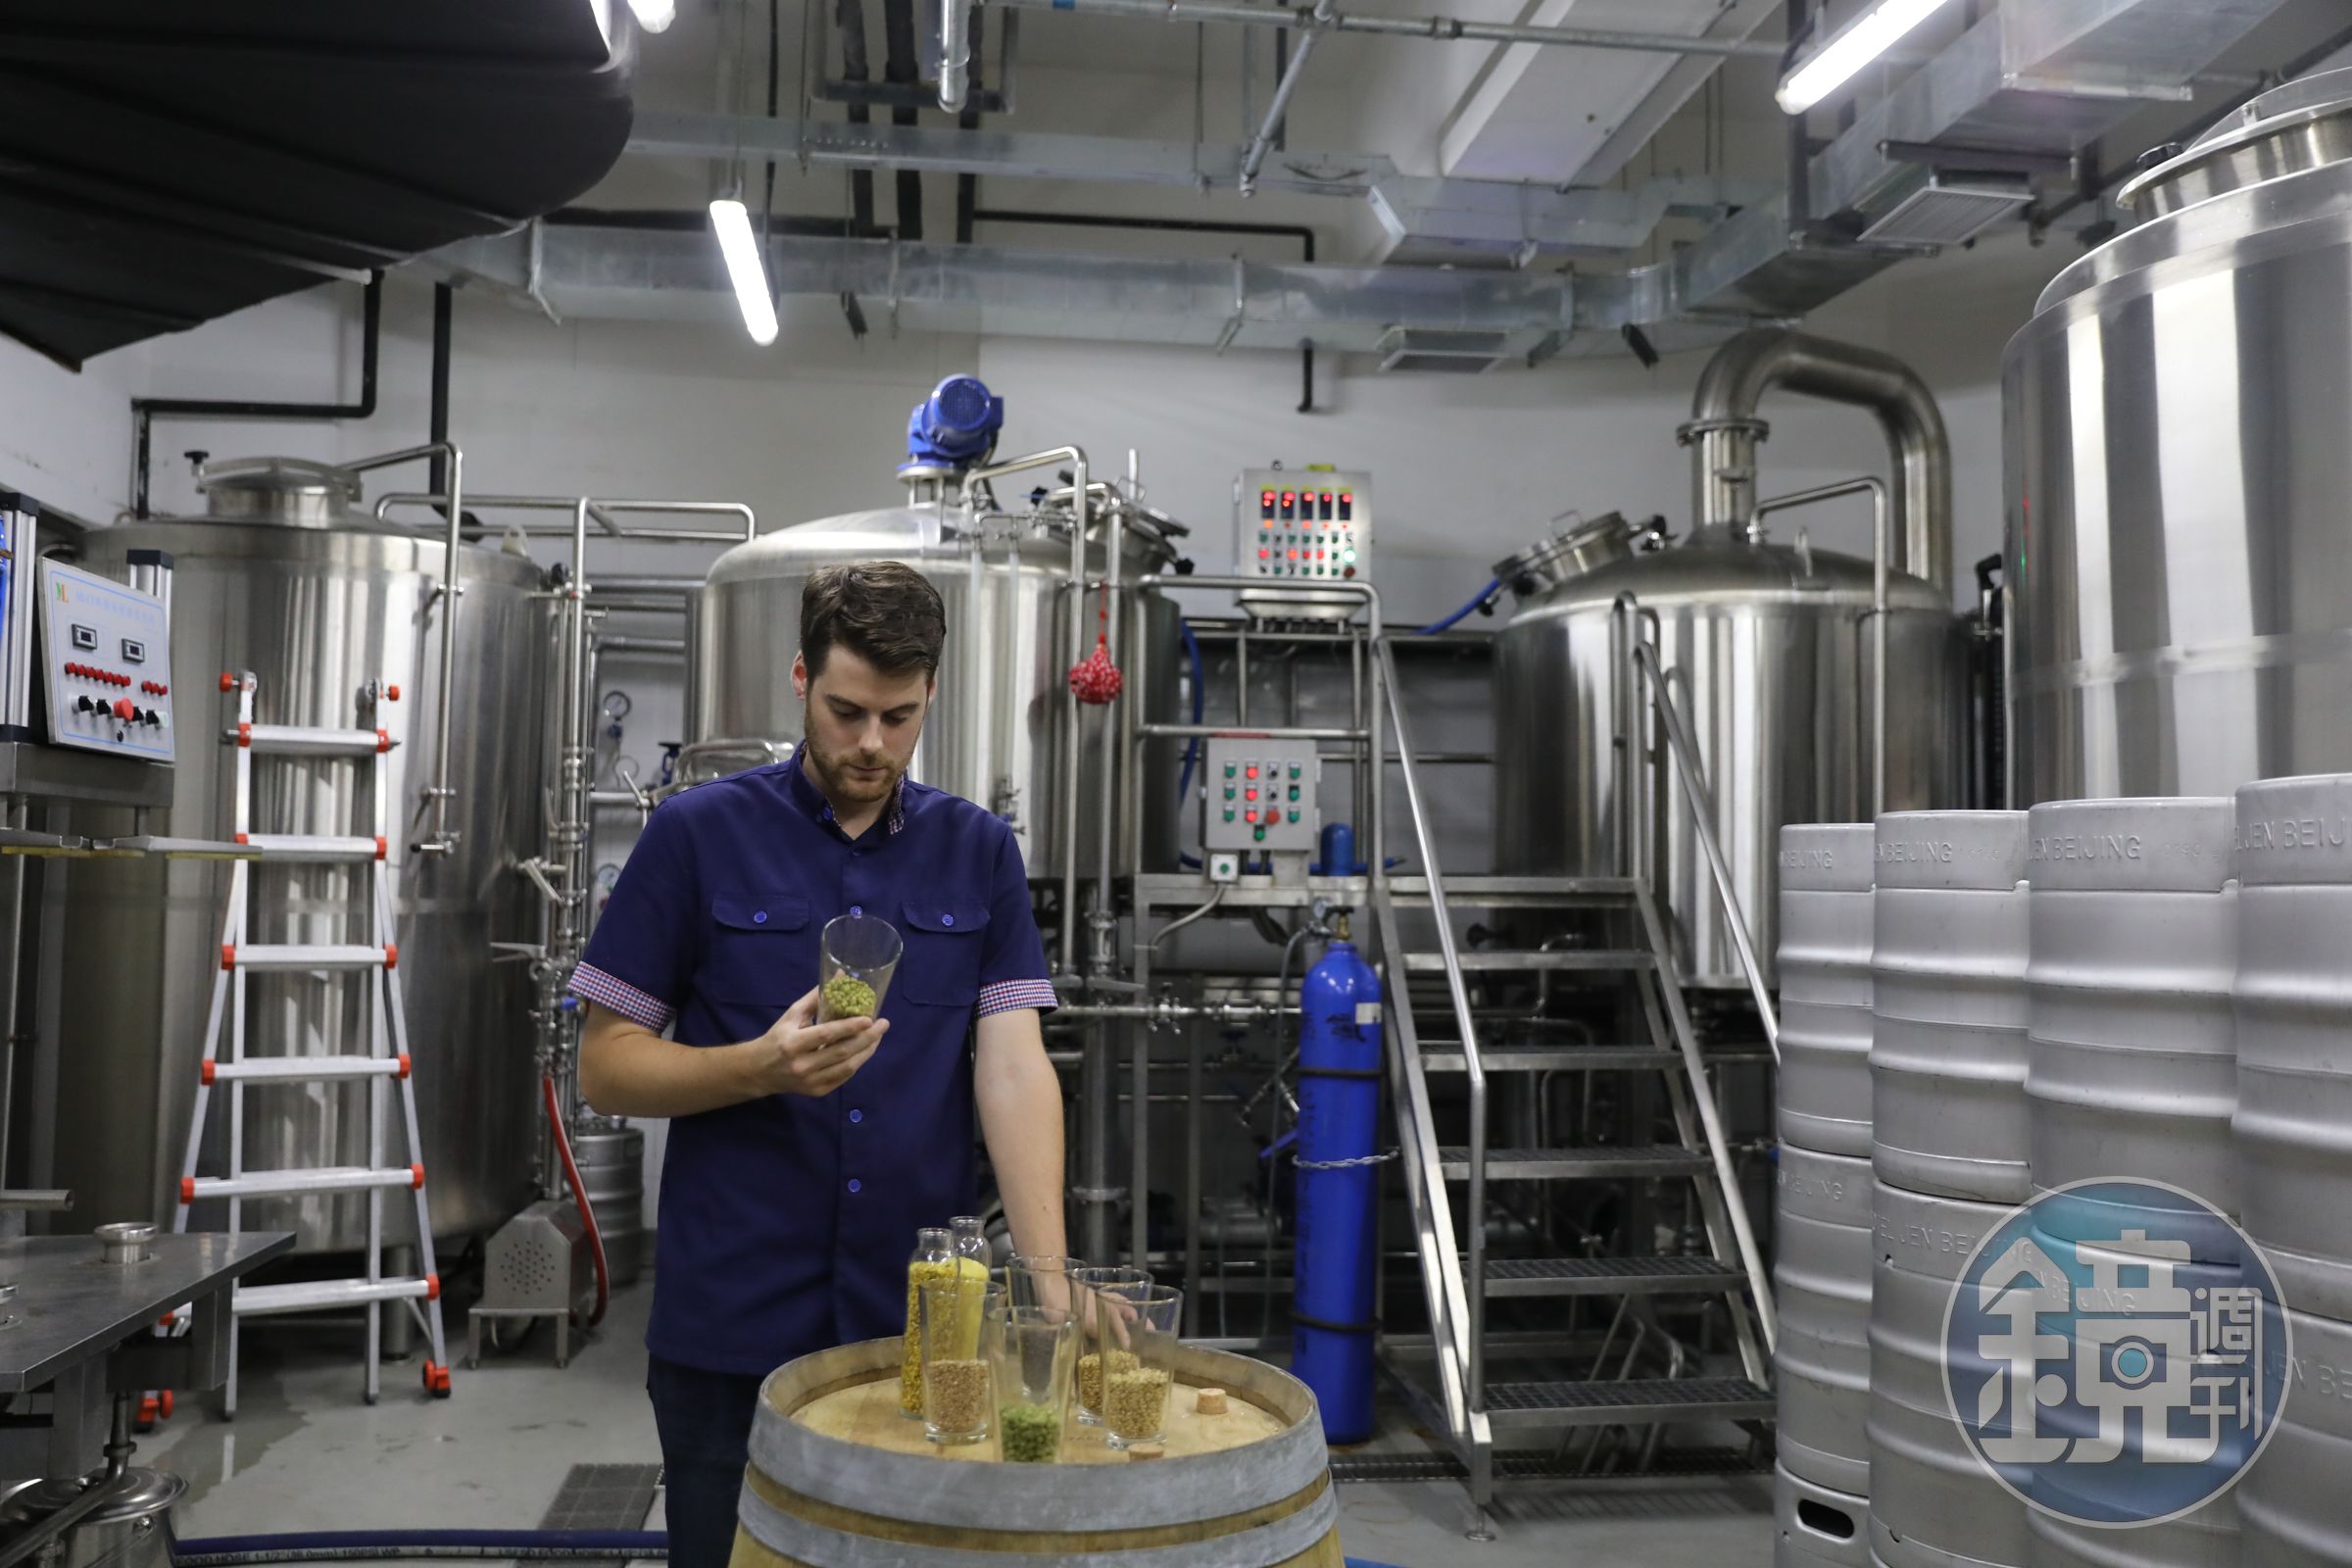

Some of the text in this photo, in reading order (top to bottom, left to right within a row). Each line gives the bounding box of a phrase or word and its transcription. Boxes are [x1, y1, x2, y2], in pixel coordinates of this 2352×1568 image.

[2054, 834, 2141, 860] BEIJING
[2244, 821, 2275, 851] JEN
[1887, 841, 1953, 863] BEIJING
